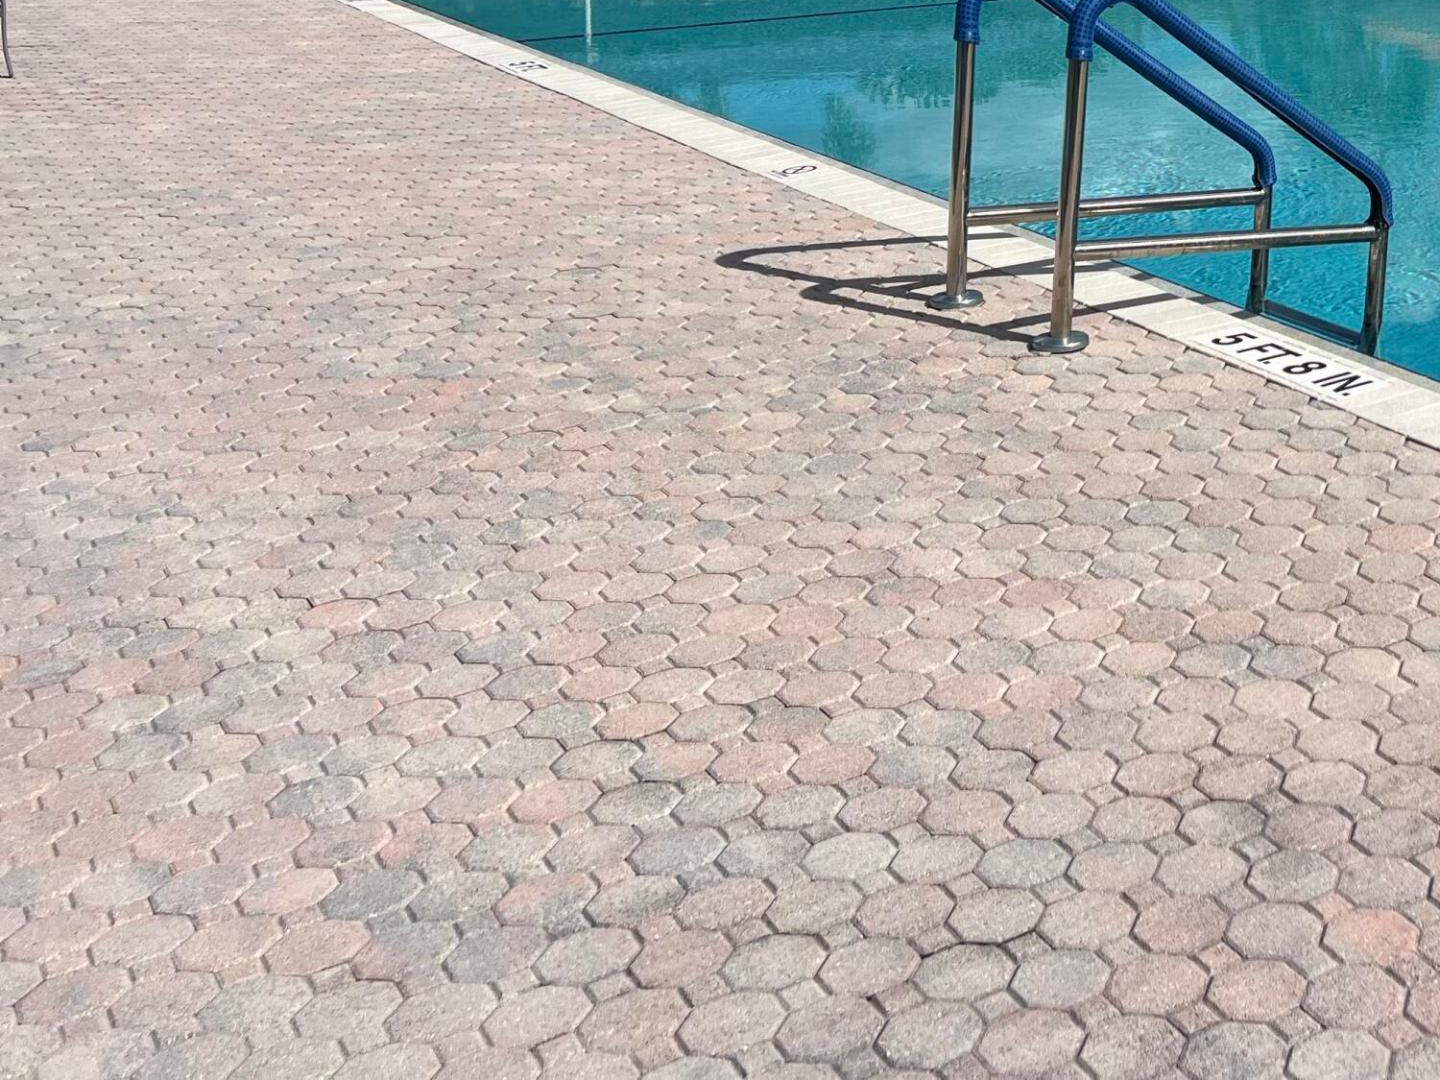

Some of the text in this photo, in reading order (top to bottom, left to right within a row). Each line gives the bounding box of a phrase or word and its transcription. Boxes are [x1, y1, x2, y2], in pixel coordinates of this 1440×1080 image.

[1211, 332, 1373, 397] 5 FT. 8 IN.
